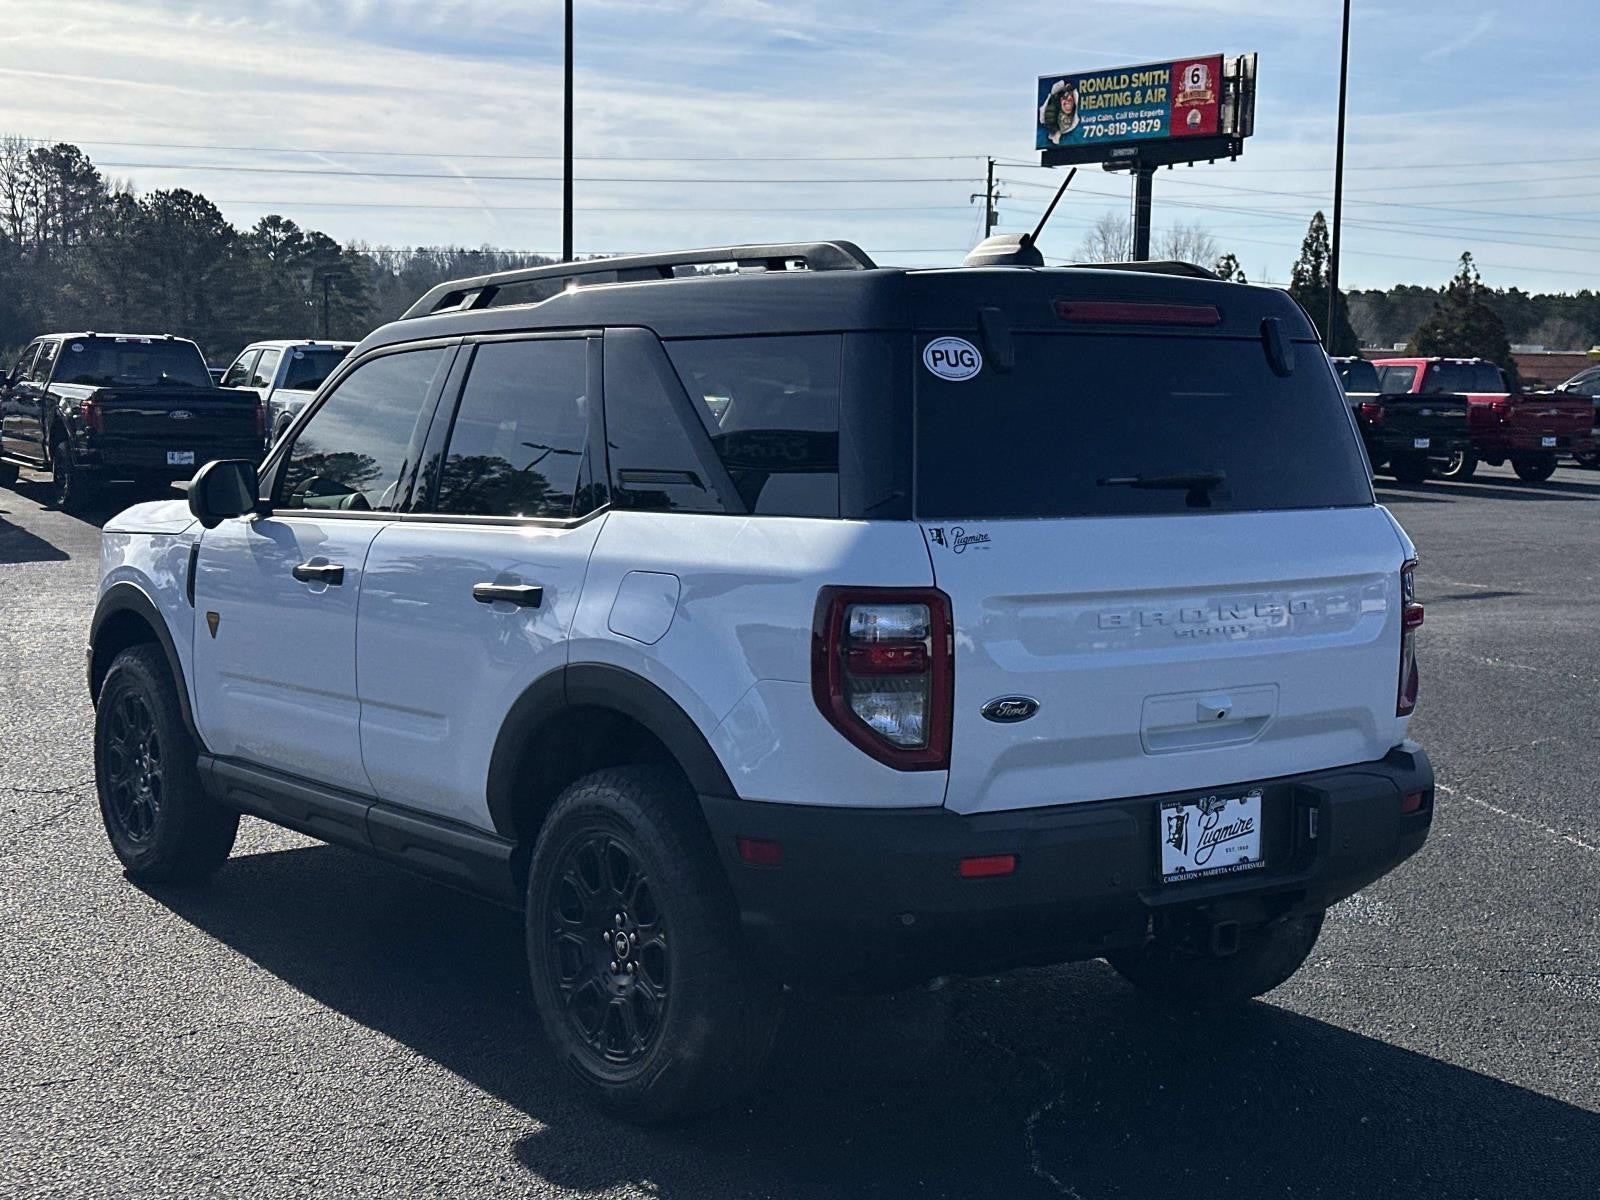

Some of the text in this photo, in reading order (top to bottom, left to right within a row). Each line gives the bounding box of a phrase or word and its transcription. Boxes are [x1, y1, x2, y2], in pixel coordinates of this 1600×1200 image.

[1079, 70, 1169, 93] RONALD SMITH
[1191, 68, 1200, 85] 6
[1080, 88, 1166, 110] HEATING & AIR
[1081, 116, 1096, 124] Keep
[1115, 112, 1127, 120] Call
[1128, 111, 1139, 119] the
[1140, 109, 1164, 118] Experts
[1083, 119, 1160, 138] 770-819-9879
[931, 349, 975, 368] PUG
[951, 526, 992, 554] Pugmire
[1097, 599, 1314, 629] BRONCO
[1194, 811, 1254, 865] Pugmire
[1202, 866, 1228, 876] MARIETTA
[1232, 860, 1265, 873] CARTERSVILLE
